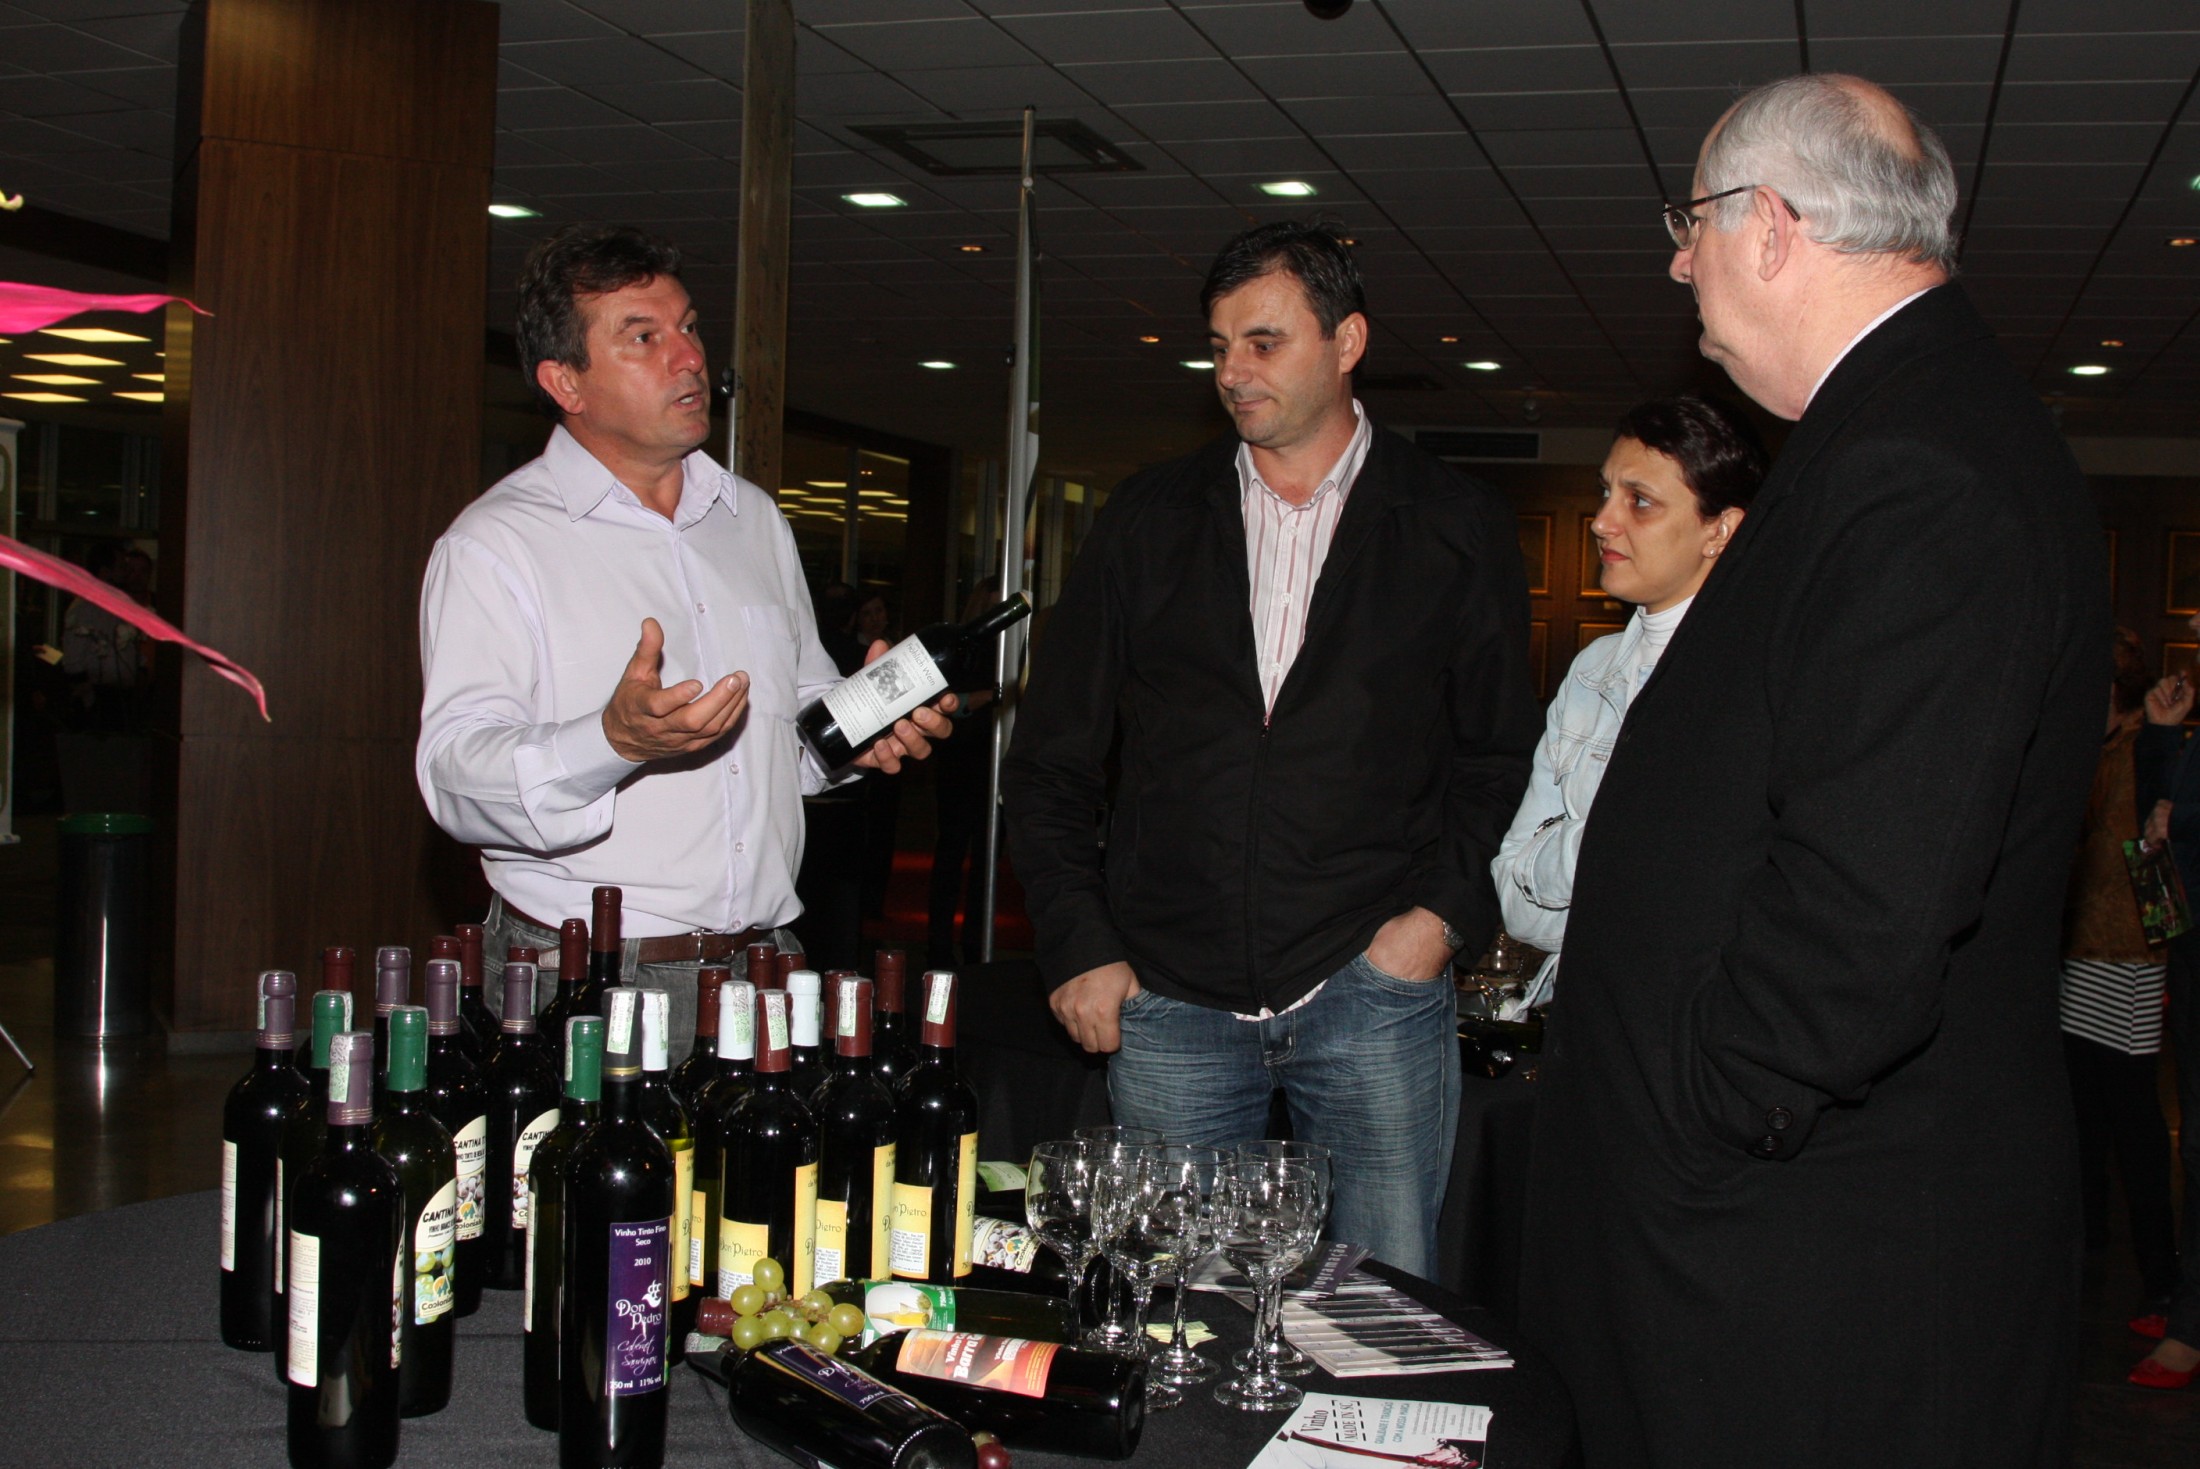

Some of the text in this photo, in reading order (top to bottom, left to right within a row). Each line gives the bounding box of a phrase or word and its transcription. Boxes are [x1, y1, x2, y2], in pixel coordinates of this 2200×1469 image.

[923, 667, 936, 686] Wein
[899, 1202, 927, 1217] Pietro
[615, 1225, 667, 1236] Vinho Tinto Fino
[635, 1238, 651, 1246] Seco
[732, 1241, 764, 1257] Pietro
[634, 1257, 652, 1267] 2010
[1310, 1243, 1348, 1290] rogramação
[615, 1299, 645, 1317] Don
[629, 1312, 662, 1330] Pedro
[945, 1339, 962, 1363] Vinho
[953, 1340, 979, 1379] Barra
[624, 1380, 634, 1388] ml
[640, 1377, 654, 1387] 11%
[1300, 1409, 1329, 1432] Vinho
[1339, 1402, 1358, 1440] MADE IN SC
